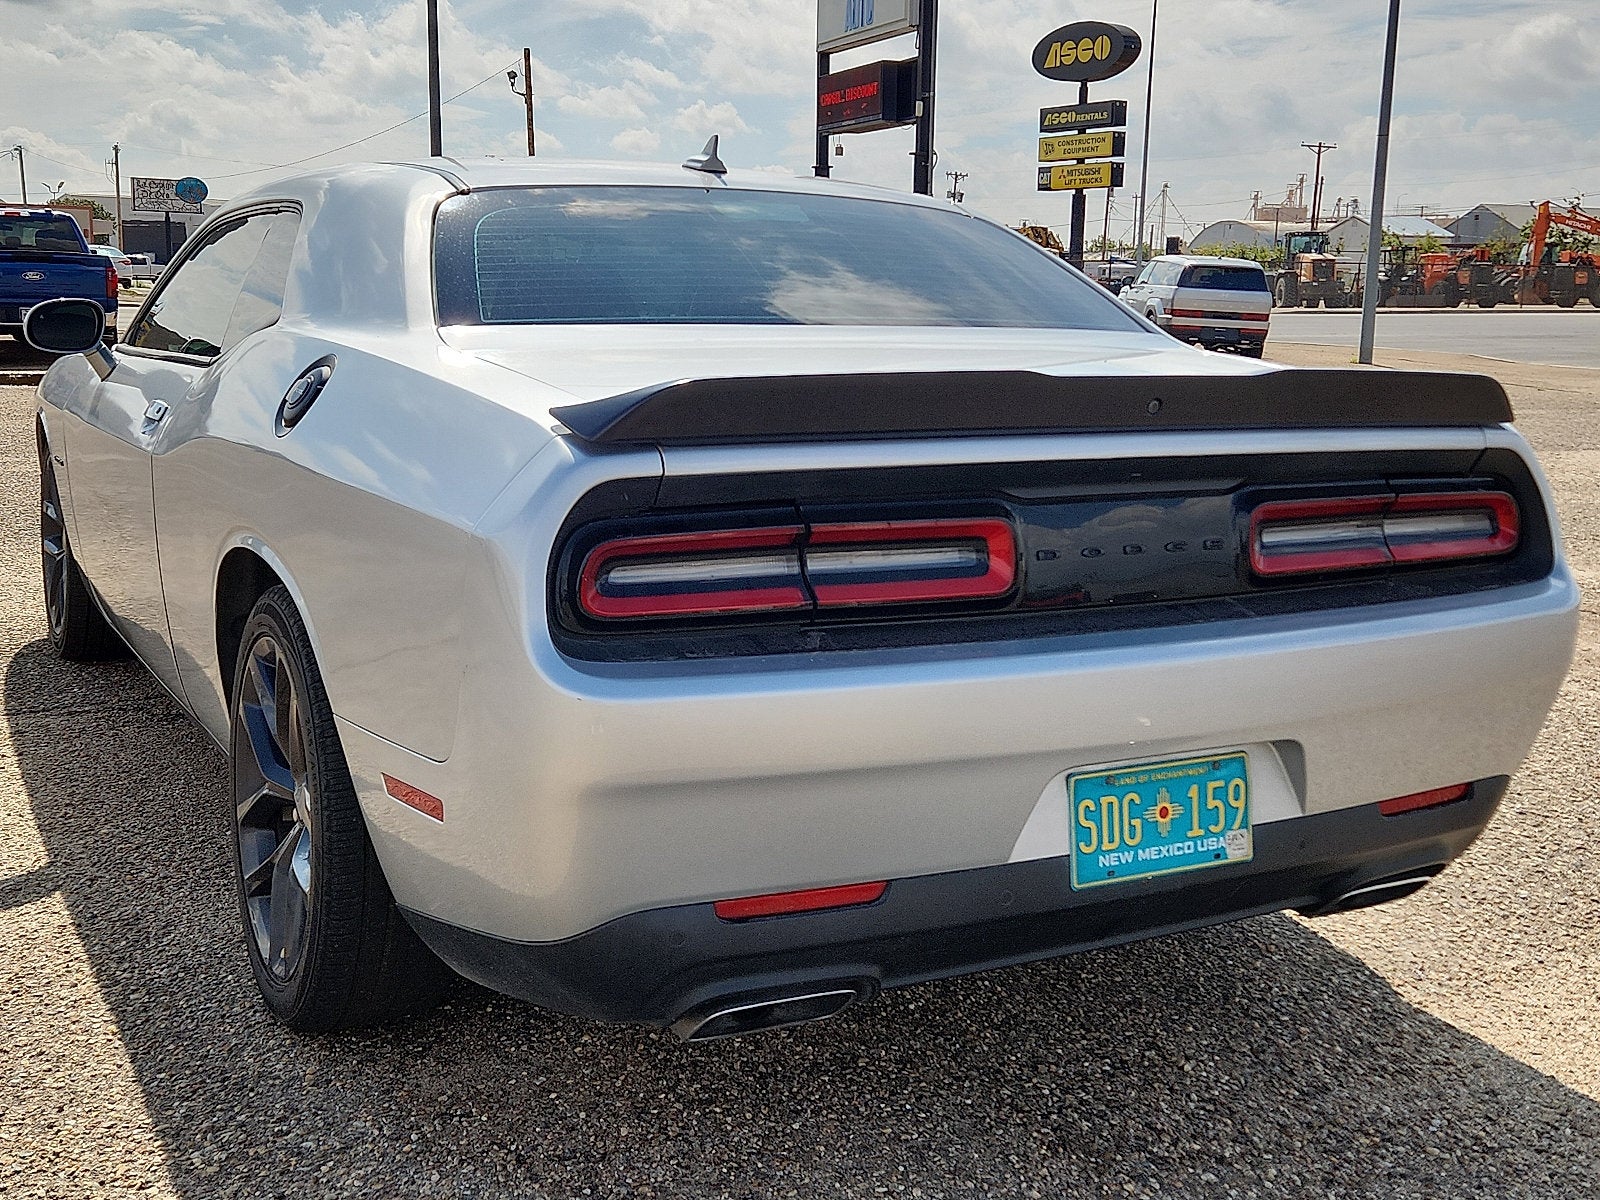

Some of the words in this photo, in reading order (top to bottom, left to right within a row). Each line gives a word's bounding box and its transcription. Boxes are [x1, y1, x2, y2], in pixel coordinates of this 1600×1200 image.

[1043, 35, 1111, 68] ASCO
[1043, 111, 1076, 126] ASCO
[1076, 111, 1108, 122] RENTALS
[1057, 137, 1106, 147] CONSTRUCTION
[1063, 145, 1099, 155] EQUIPMENT
[1066, 168, 1101, 177] MITSUBISHI
[1064, 178, 1077, 186] LIFT
[1079, 176, 1103, 185] TRUCKS
[1036, 537, 1224, 561] DODGE
[1078, 792, 1143, 854] SDG
[1186, 777, 1246, 838] 159
[1098, 848, 1134, 868] NEW
[1137, 840, 1195, 862] MEXICO
[1197, 836, 1226, 851] USA
